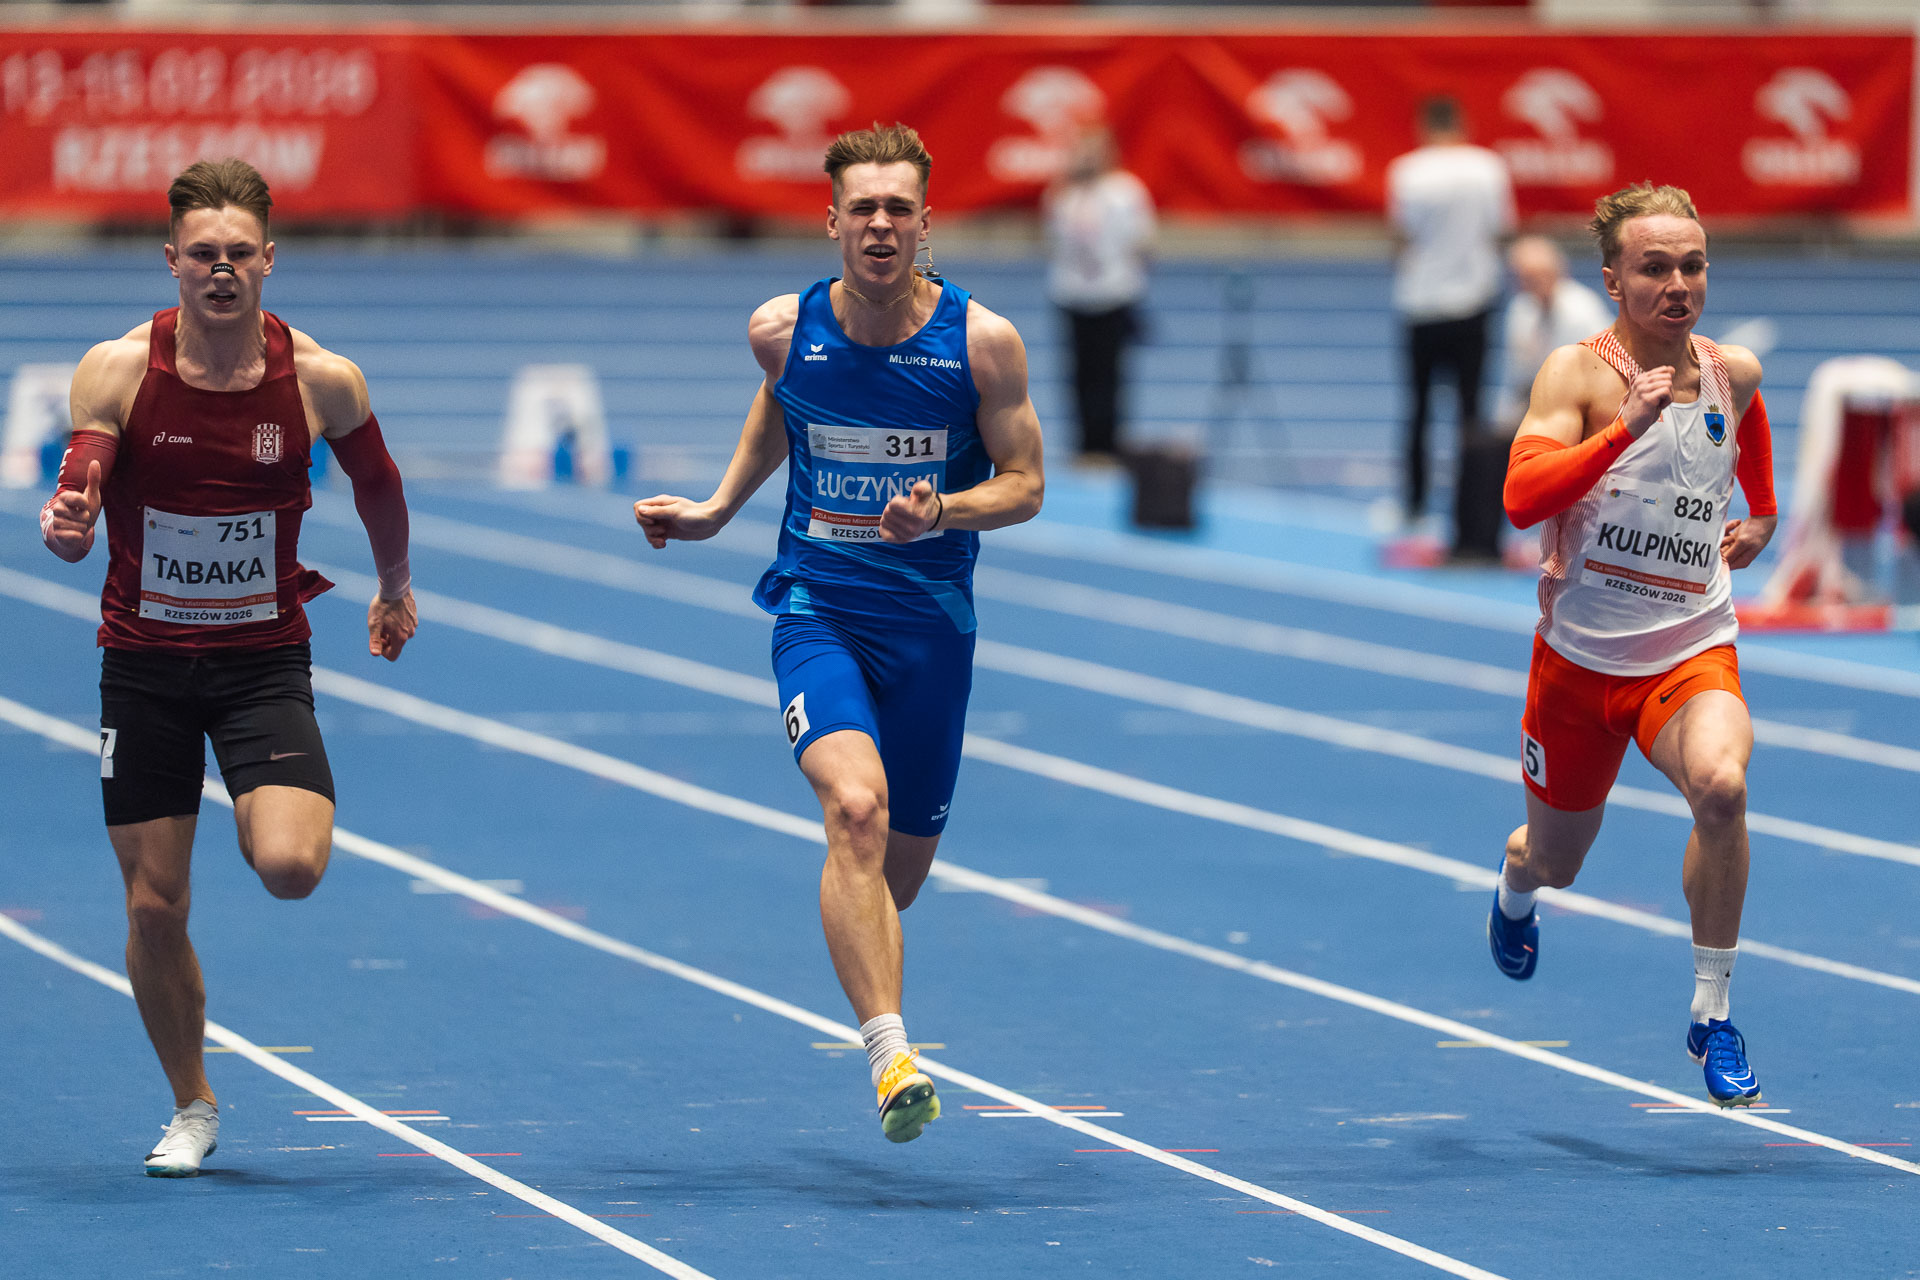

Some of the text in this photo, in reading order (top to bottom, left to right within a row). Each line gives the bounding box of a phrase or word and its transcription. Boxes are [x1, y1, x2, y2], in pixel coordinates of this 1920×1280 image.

[889, 354, 962, 370] MLUKS RAWA
[168, 436, 193, 444] CUNA
[885, 435, 934, 458] 311
[1673, 495, 1713, 523] 828
[217, 517, 265, 543] 751
[1597, 522, 1711, 568] KULPIŃSKI
[153, 553, 266, 584] TABAKA
[1605, 578, 1687, 604] RZESZÓW 2026
[164, 608, 253, 621] RZESZÓW 2026
[786, 705, 800, 743] 6
[1525, 737, 1539, 777] 5
